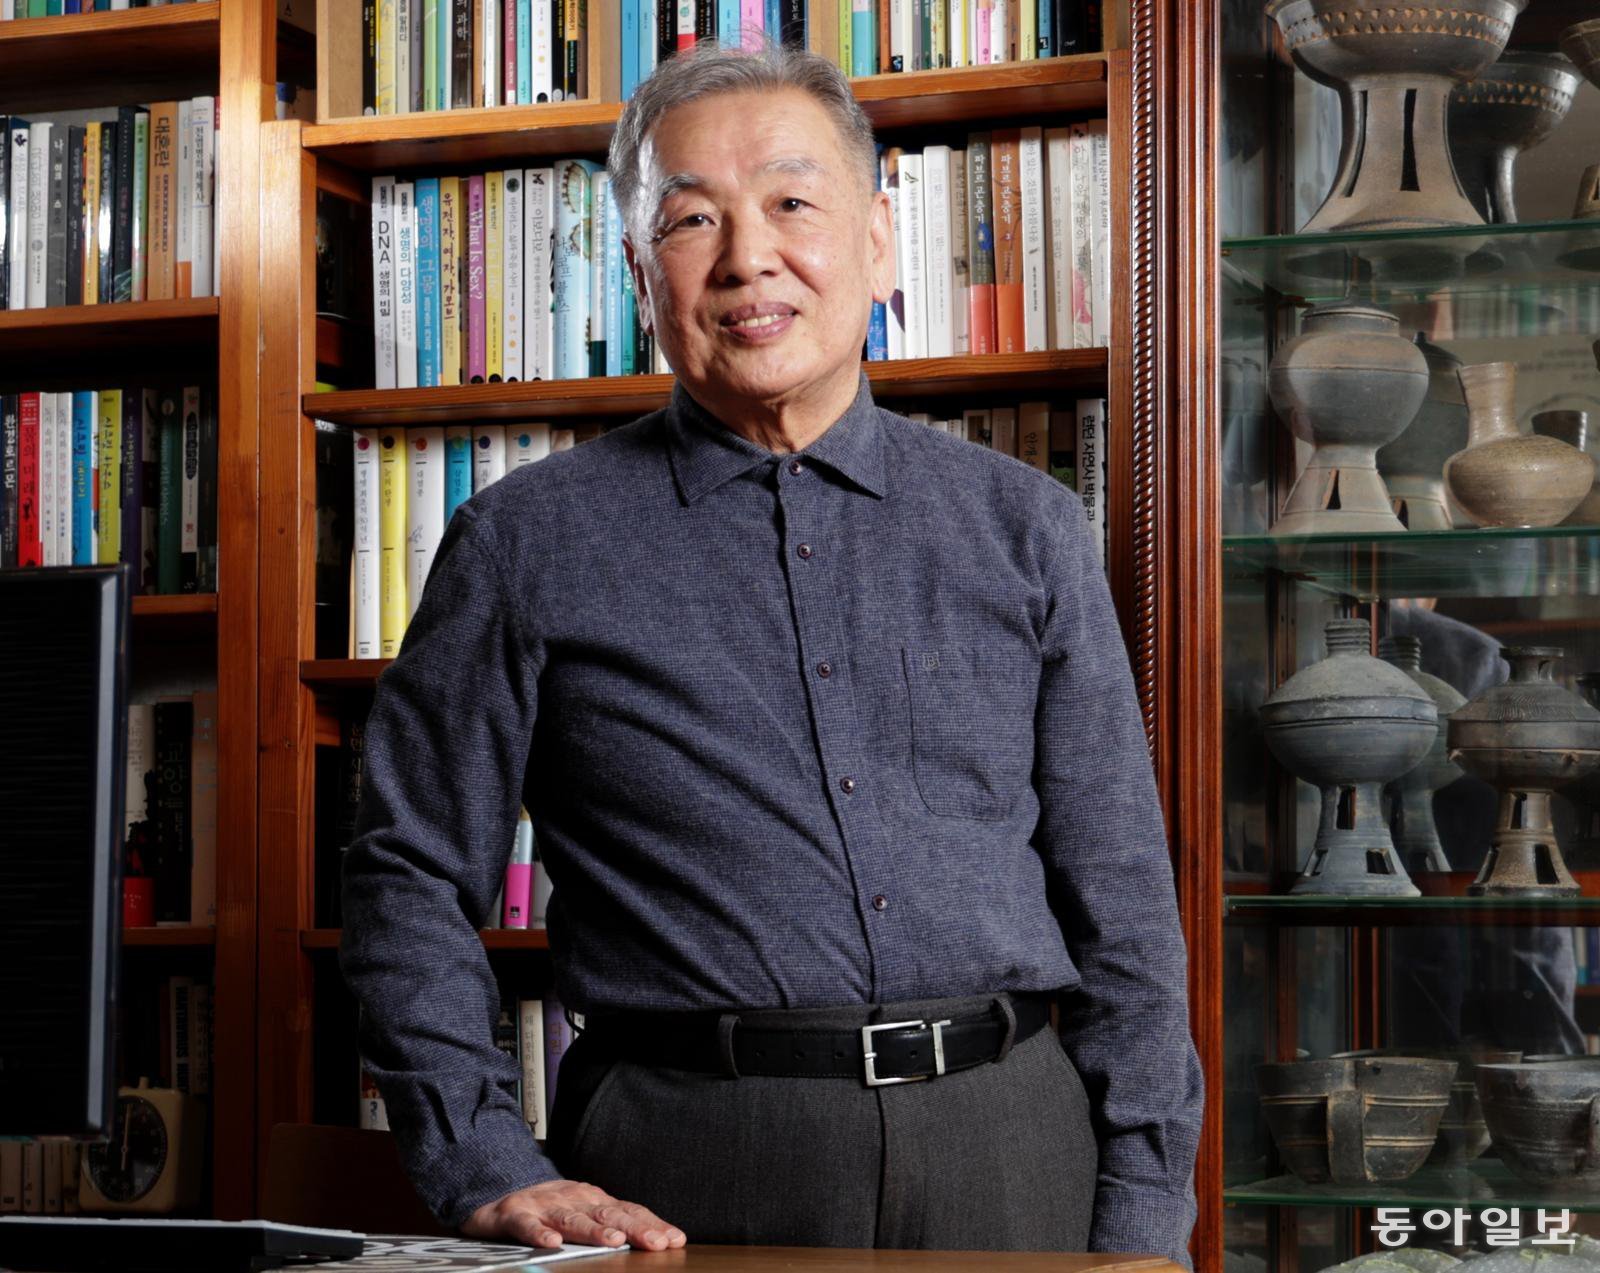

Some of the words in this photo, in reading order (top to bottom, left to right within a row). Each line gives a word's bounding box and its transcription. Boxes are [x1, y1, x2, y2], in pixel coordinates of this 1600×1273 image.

[154, 116, 171, 168] 대혼란
[195, 126, 204, 168] 전염병의
[974, 154, 985, 183] 파브르
[1000, 153, 1011, 183] 파브르
[1027, 157, 1038, 177] 있는
[195, 170, 204, 203] 세계사
[910, 188, 919, 203] 나는
[1027, 179, 1038, 205] 것들의
[443, 192, 455, 240] 유전자,
[974, 187, 985, 224] 곤충기
[1000, 188, 1011, 225] 곤충기
[420, 195, 433, 250] 생명의
[469, 208, 483, 246] What
[532, 208, 543, 253] 이보디보
[910, 222, 919, 245] 나비를
[1027, 208, 1038, 243] 아름다움
[378, 221, 391, 264] DNA
[400, 227, 411, 263] 생명의
[470, 251, 483, 265] Is
[910, 247, 919, 271] 그린다
[420, 259, 435, 294] 그물
[443, 247, 455, 277] 여자,
[379, 271, 390, 297] 생명의
[400, 268, 411, 304] 다양성
[469, 268, 483, 300] Sex?
[509, 270, 518, 288] 사이
[379, 300, 390, 317] 비밀
[74, 418, 87, 455] 시크릿
[103, 416, 114, 449] 시크릿
[1024, 431, 1038, 456] 안개
[1082, 415, 1096, 440] 런던
[5, 414, 16, 488] 환경호르몬
[1082, 442, 1096, 480] 자연사
[103, 455, 114, 491] 하우스
[416, 469, 424, 498] 대멸종
[454, 468, 462, 497] 삼엽충
[384, 489, 393, 508] 탄생
[524, 1015, 534, 1025] 왜
[550, 1022, 562, 1055] 다윈
